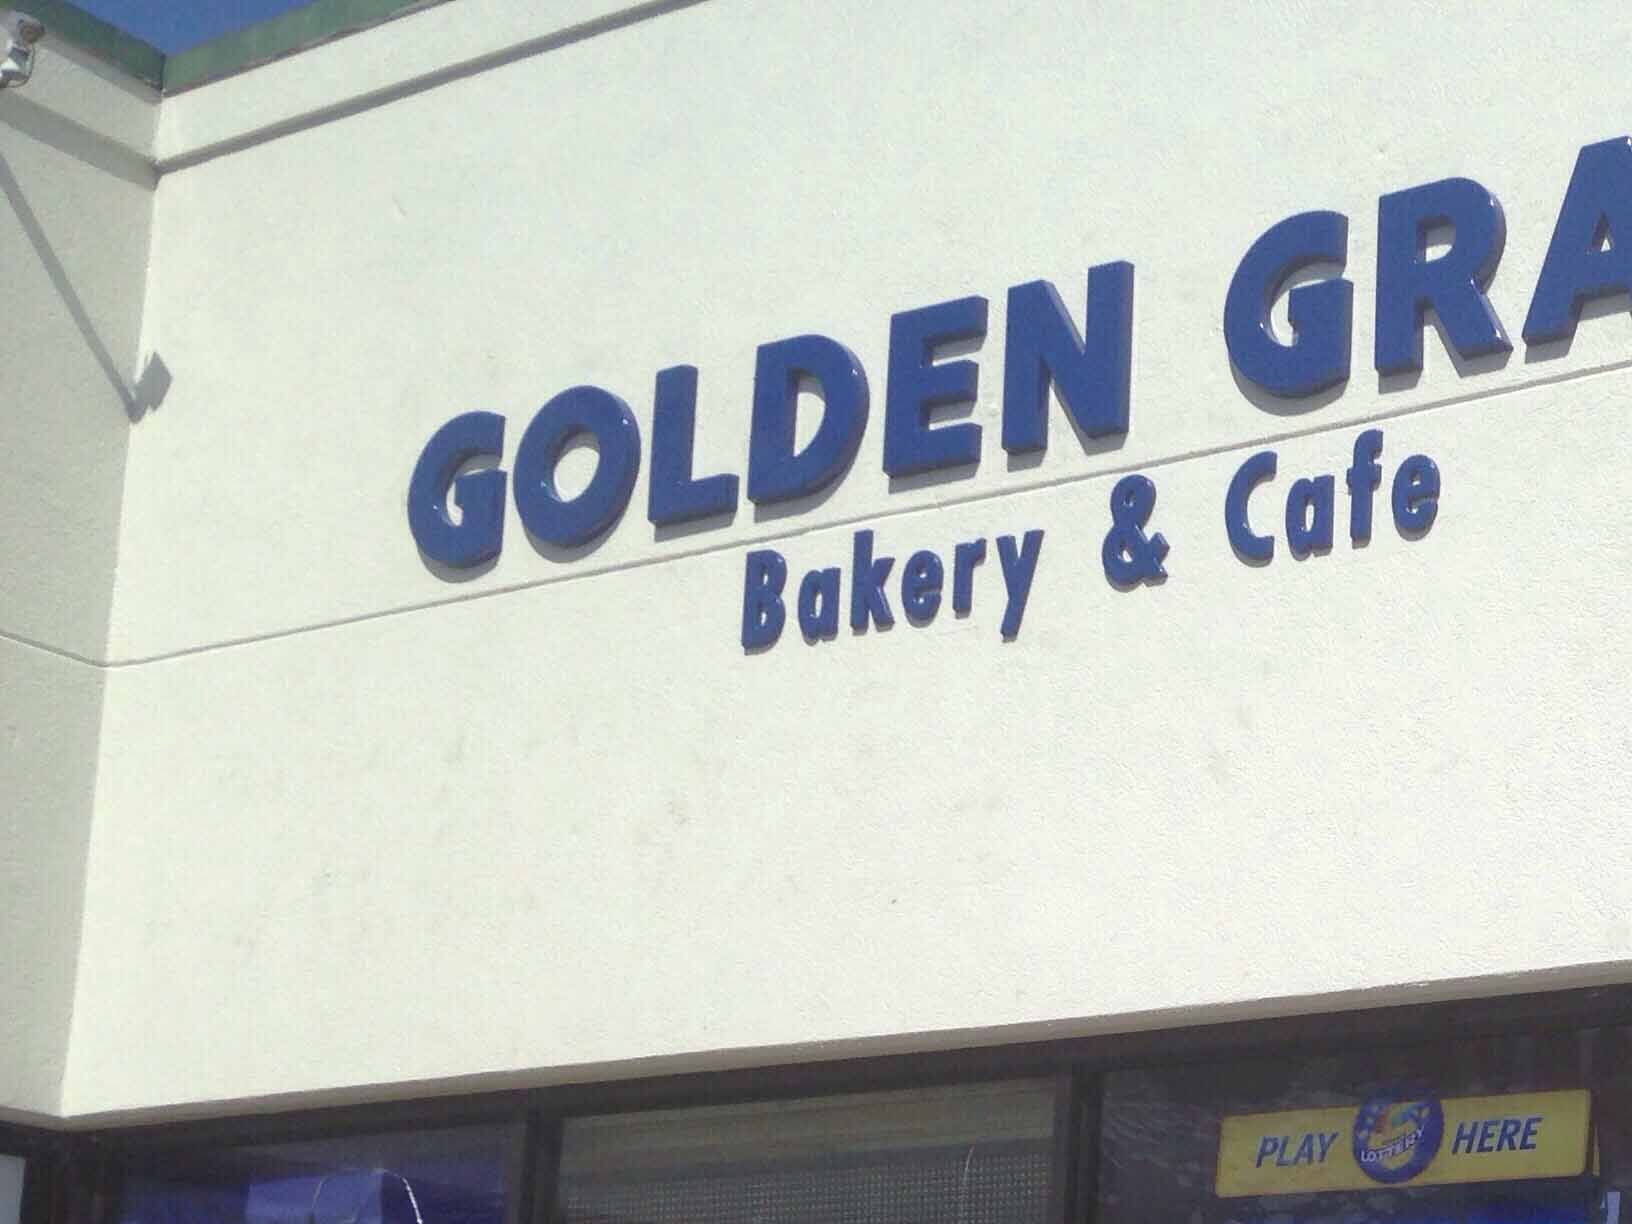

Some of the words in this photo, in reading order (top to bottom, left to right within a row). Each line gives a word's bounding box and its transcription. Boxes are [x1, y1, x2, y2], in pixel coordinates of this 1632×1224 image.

[407, 260, 1134, 574] GOLDEN
[742, 529, 1044, 655] Bakery
[1102, 474, 1169, 592] &
[1225, 429, 1441, 566] Cafe
[1256, 1131, 1339, 1169] PLAY
[1452, 1117, 1543, 1155] HERE
